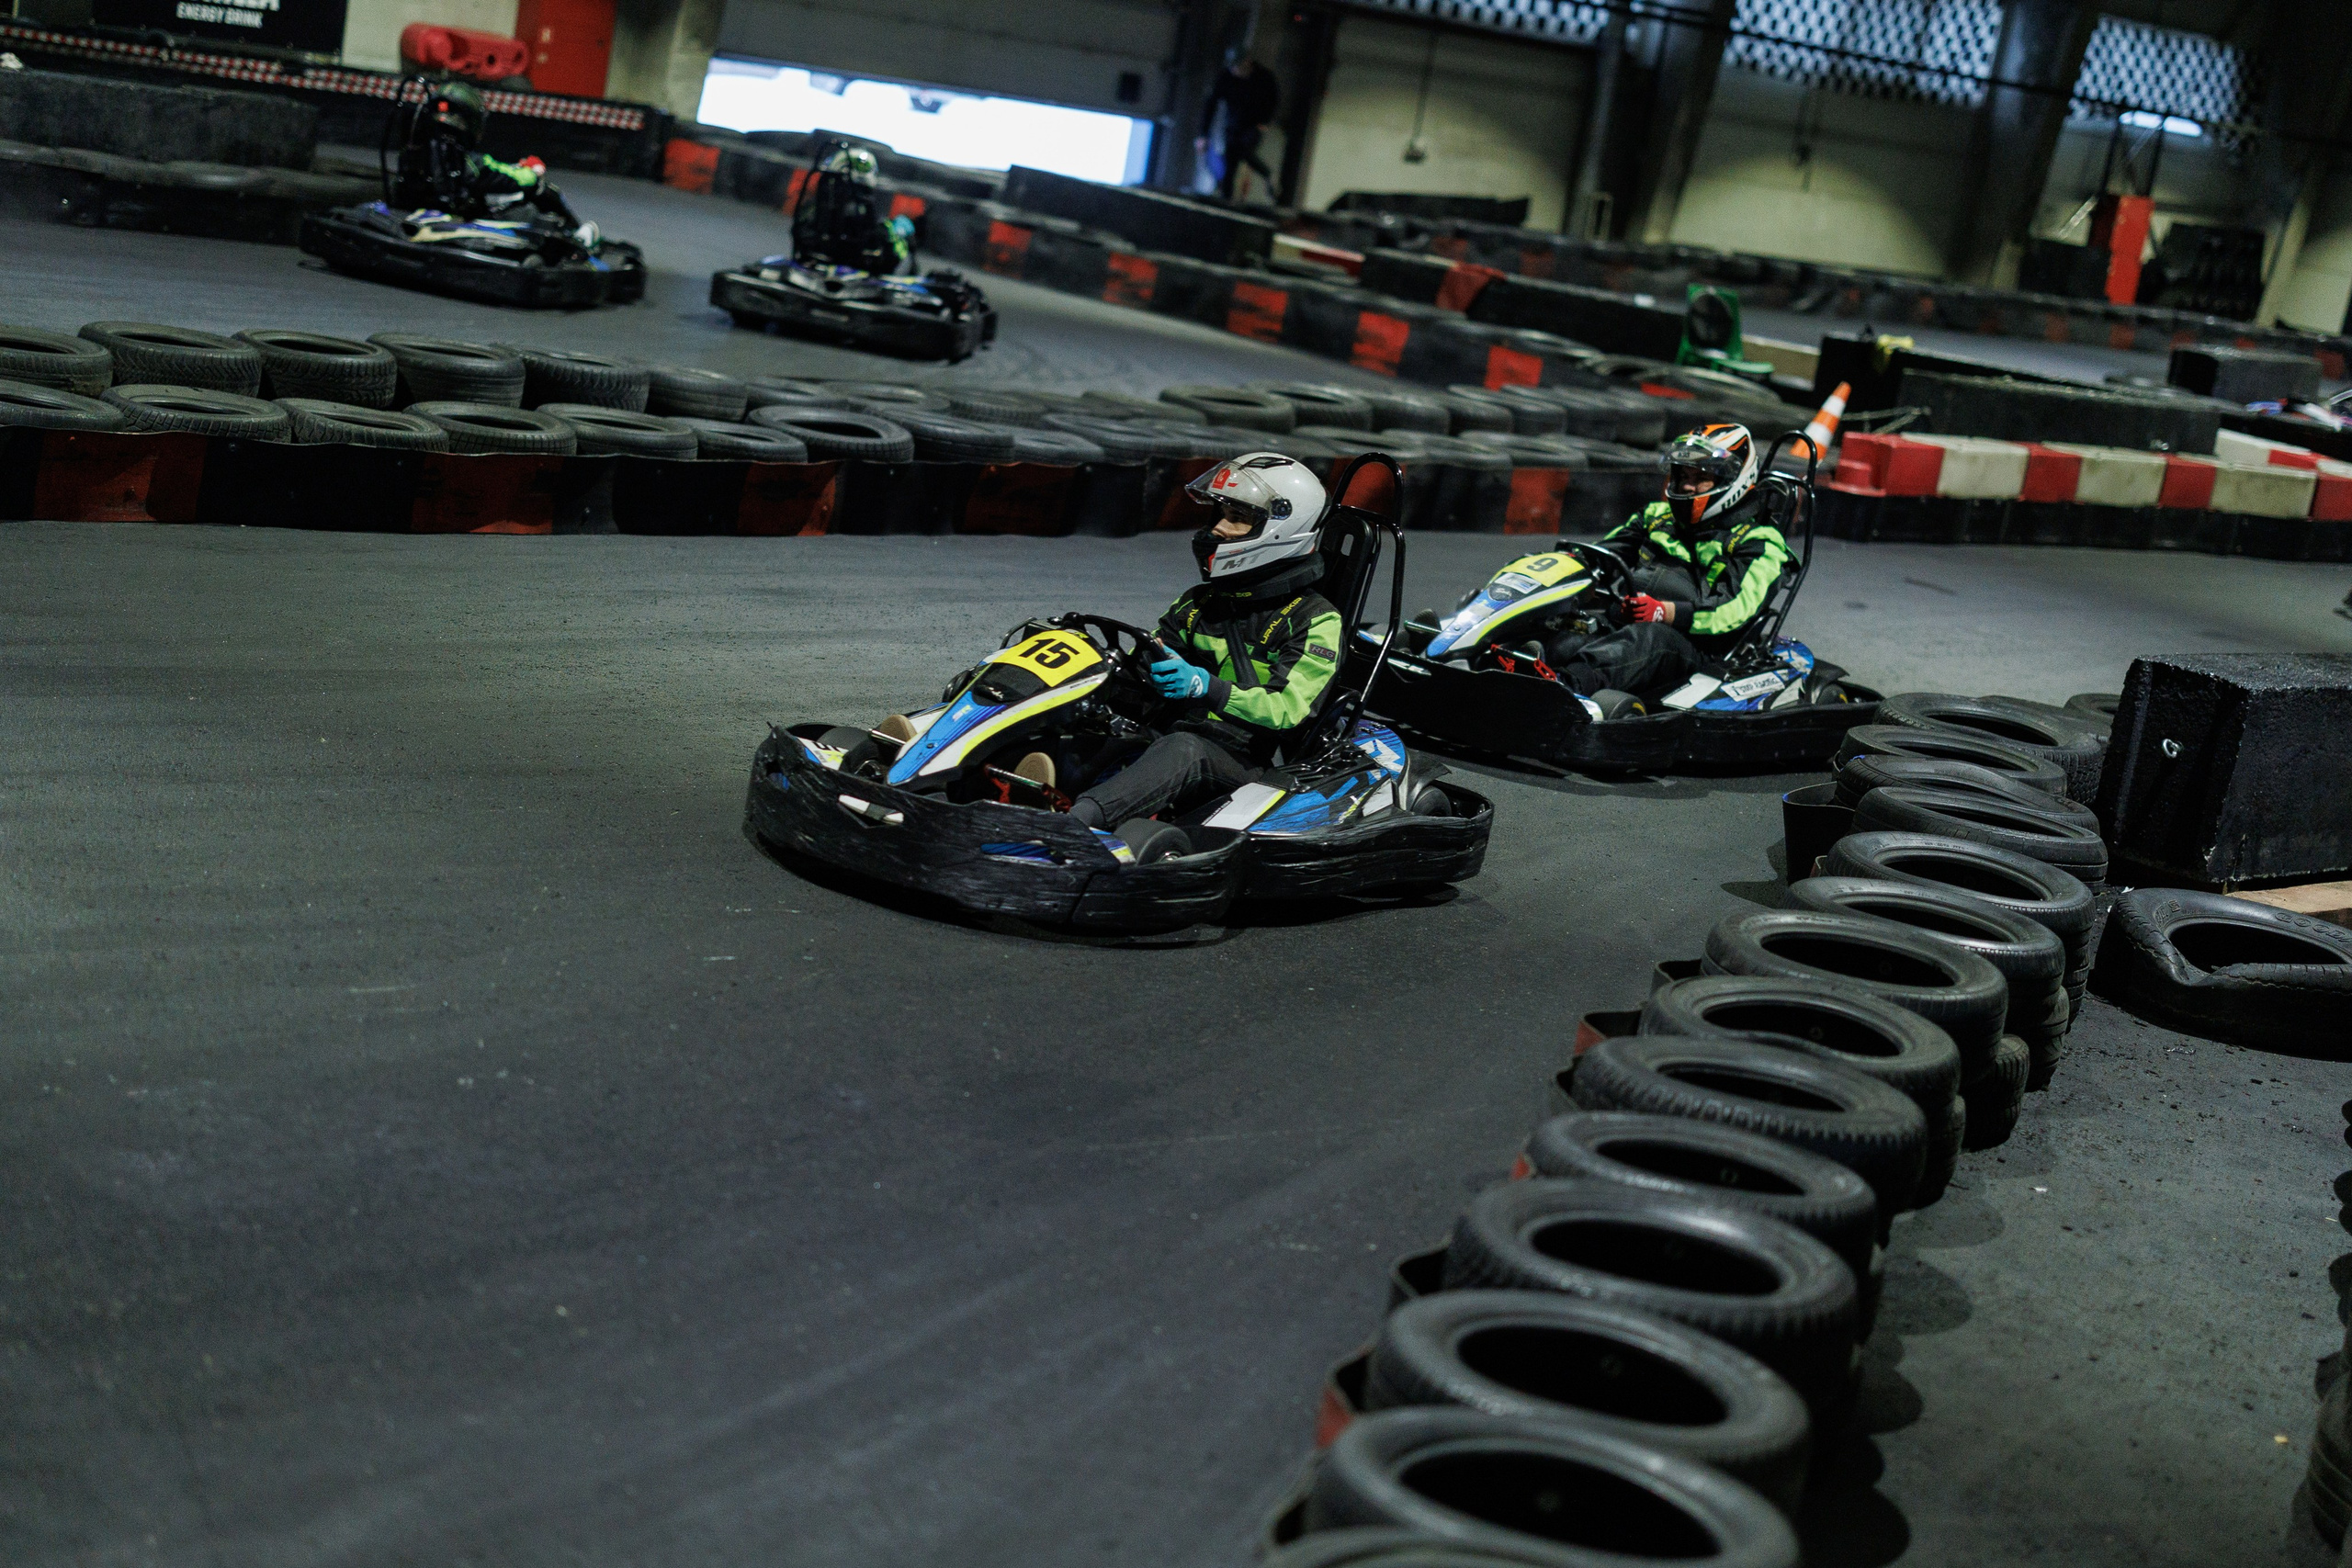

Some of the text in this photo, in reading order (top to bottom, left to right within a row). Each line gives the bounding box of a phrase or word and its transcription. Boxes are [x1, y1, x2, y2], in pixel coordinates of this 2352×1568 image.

[175, 1, 223, 24] ENERGY
[224, 7, 264, 29] DRINK
[1221, 550, 1269, 570] MT
[1526, 558, 1558, 572] 9
[1260, 617, 1283, 645] URAL
[1018, 637, 1080, 669] 15
[1311, 646, 1335, 659] RLG
